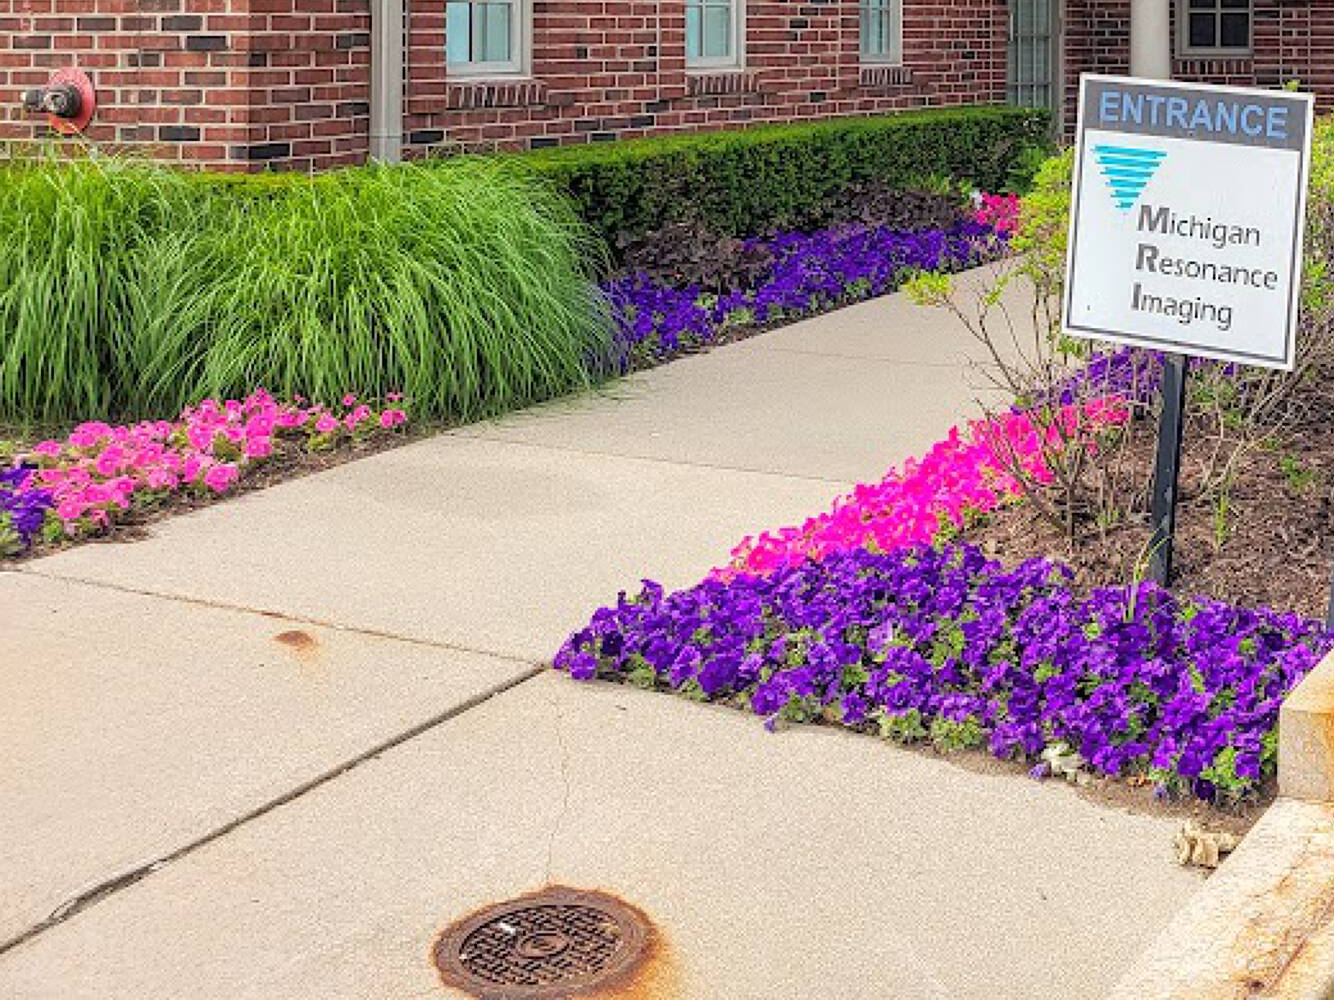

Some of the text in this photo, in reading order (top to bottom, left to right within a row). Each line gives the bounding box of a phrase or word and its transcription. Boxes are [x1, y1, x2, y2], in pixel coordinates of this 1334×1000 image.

[1099, 91, 1288, 139] ENTRANCE
[1137, 205, 1261, 248] Michigan
[1135, 244, 1278, 289] Resonance
[1131, 283, 1232, 331] Imaging
